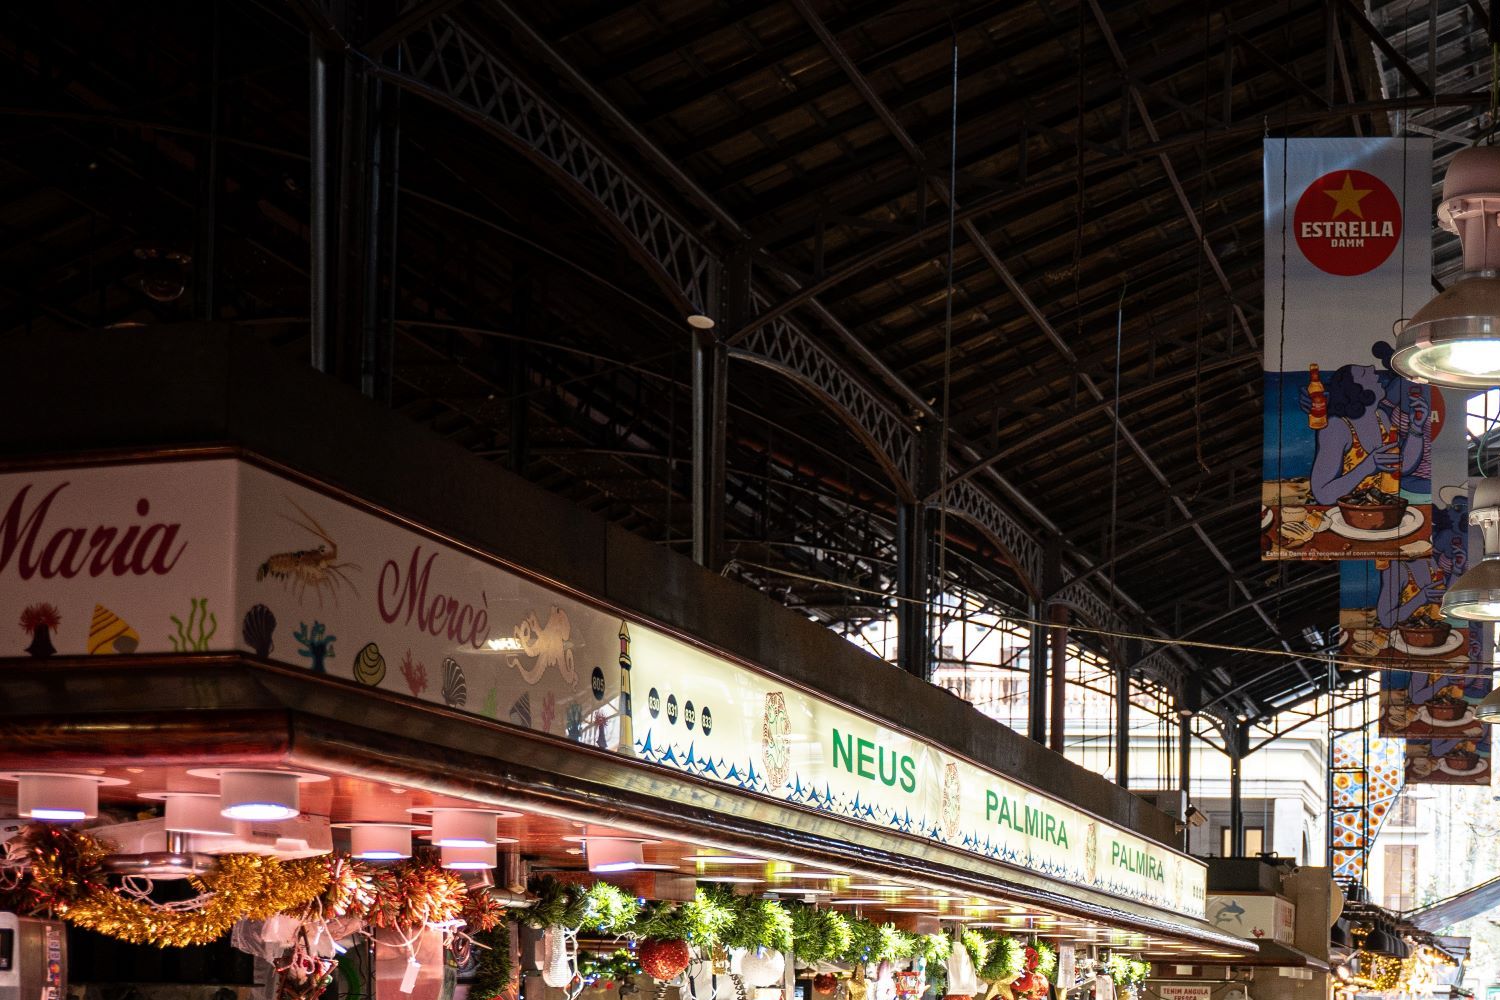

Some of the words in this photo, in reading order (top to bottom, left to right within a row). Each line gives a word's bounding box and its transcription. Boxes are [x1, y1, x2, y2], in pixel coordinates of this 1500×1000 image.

[1301, 221, 1395, 238] ESTRELLA
[1330, 238, 1364, 248] DAMM
[0, 481, 188, 581] Maria
[378, 545, 491, 650] Mercè
[832, 728, 916, 794] NEUS
[986, 789, 1069, 850] PALMIRA
[1112, 840, 1165, 883] PALMIRA
